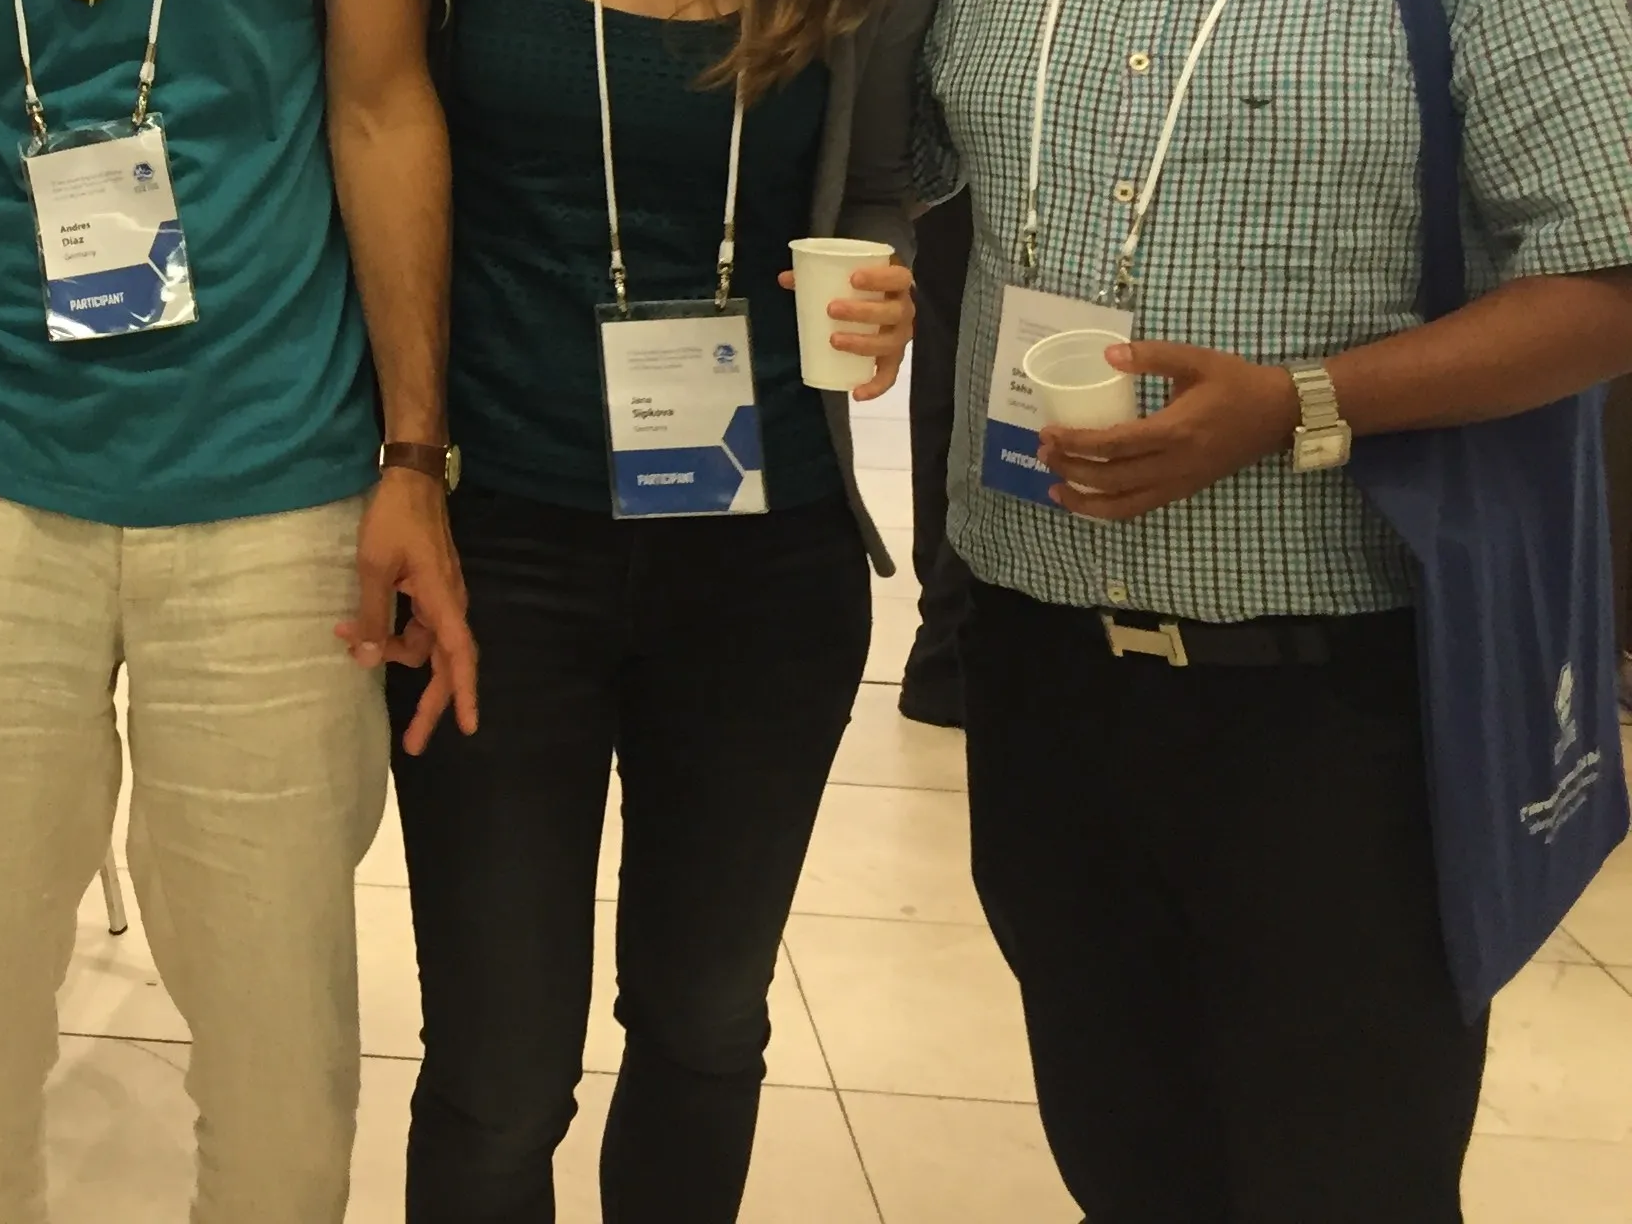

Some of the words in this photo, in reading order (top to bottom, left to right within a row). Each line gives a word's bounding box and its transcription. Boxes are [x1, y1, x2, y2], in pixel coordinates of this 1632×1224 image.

[60, 221, 91, 233] Andres
[69, 291, 125, 311] PARTICIPANT
[636, 472, 695, 487] PARTICIPANT
